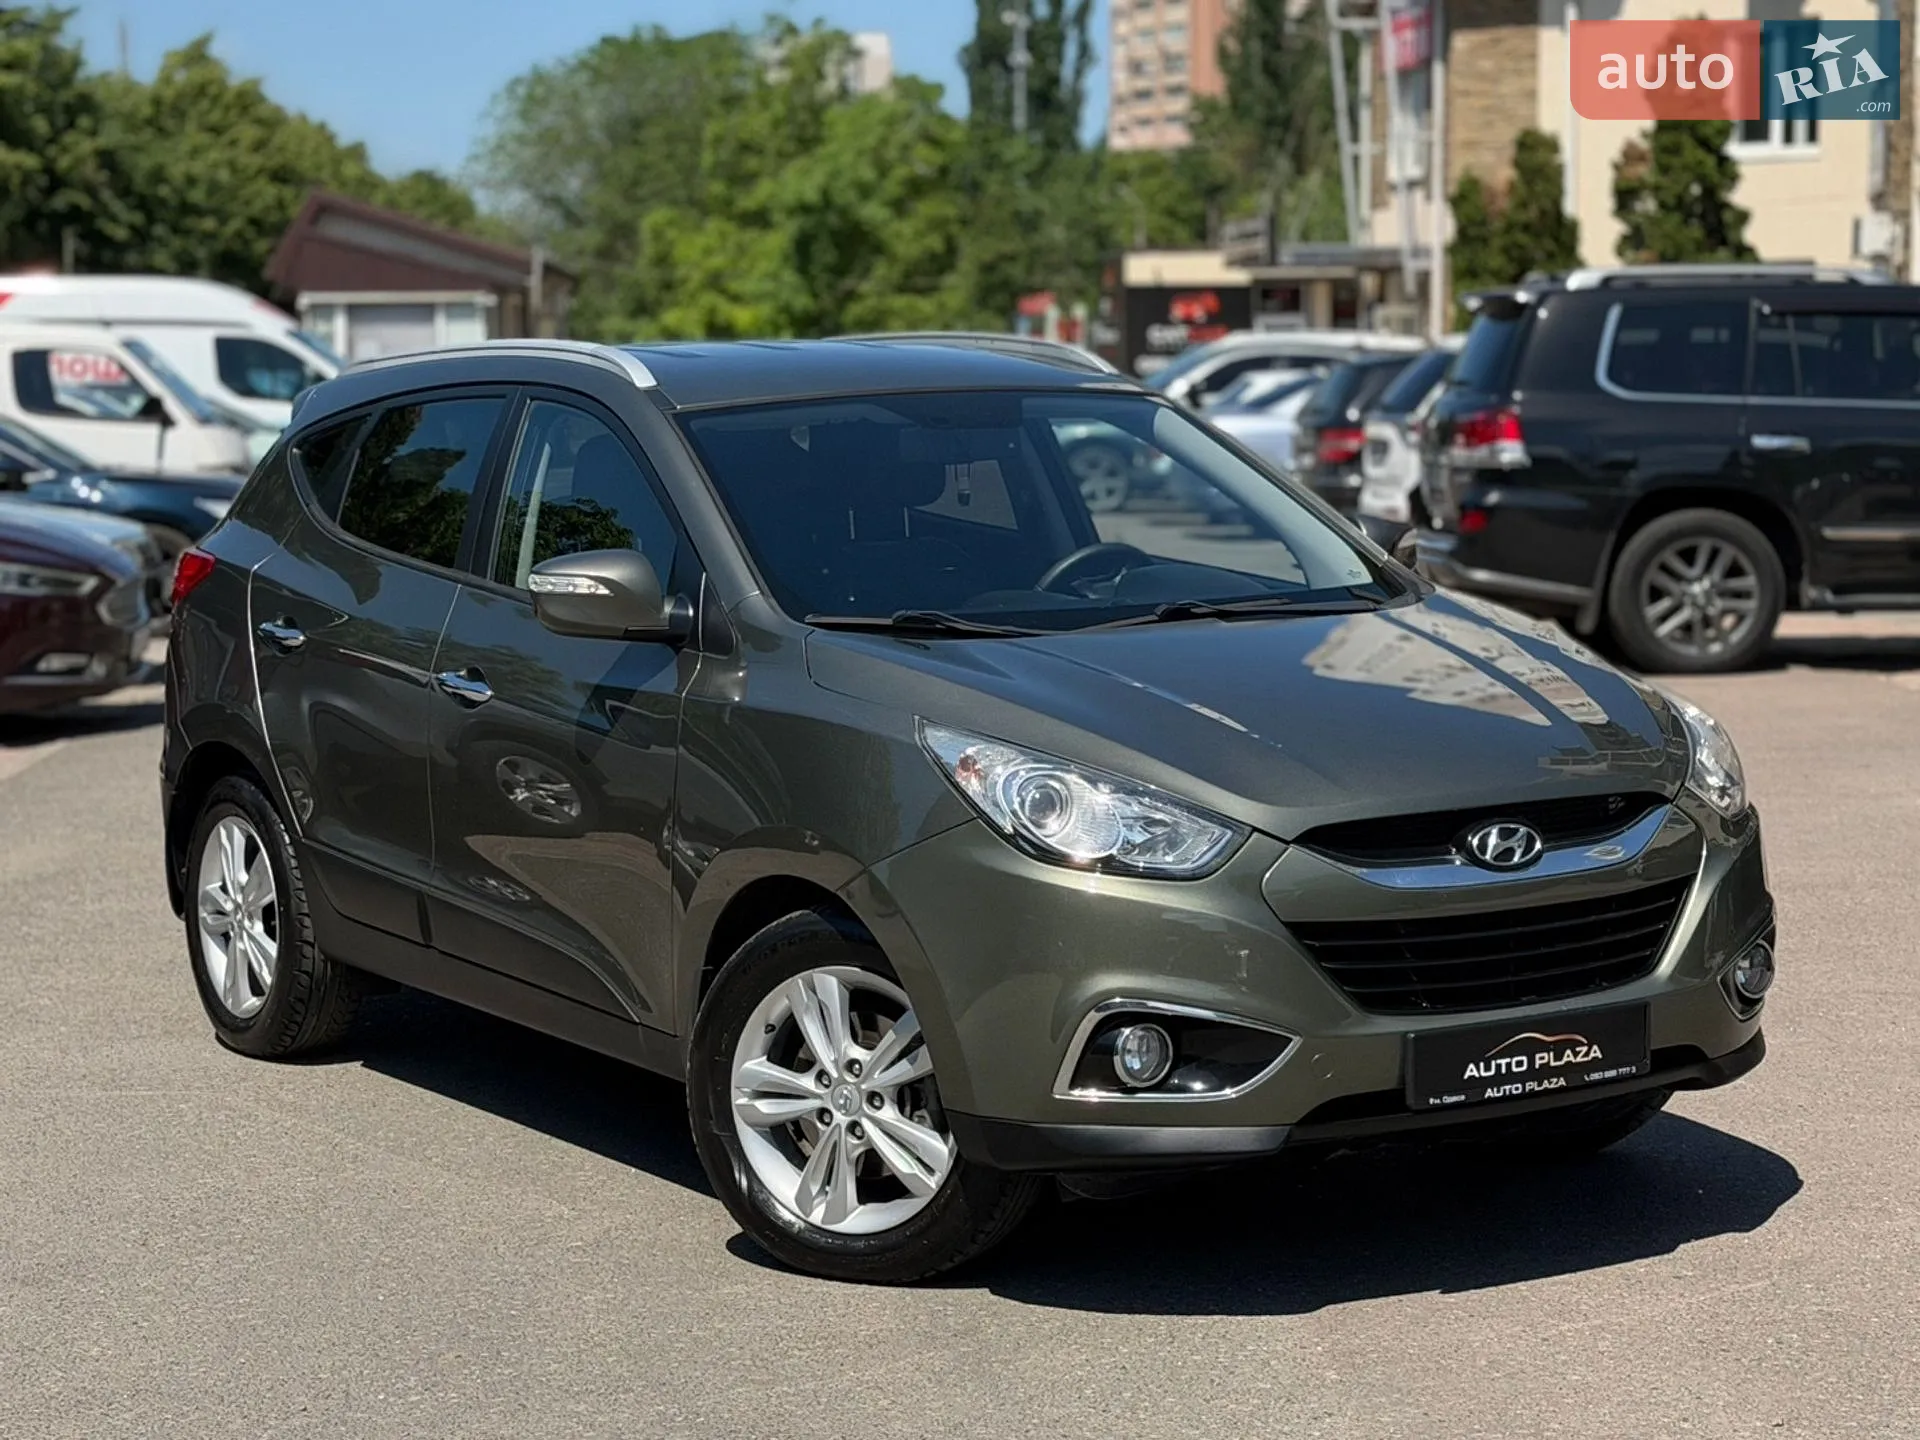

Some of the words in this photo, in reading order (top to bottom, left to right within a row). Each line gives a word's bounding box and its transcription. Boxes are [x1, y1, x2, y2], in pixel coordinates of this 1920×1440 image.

[1463, 1055, 1528, 1080] AUTO
[1534, 1044, 1603, 1069] PLAZA
[1484, 1083, 1523, 1099] AUTO
[1525, 1077, 1567, 1093] PLAZA
